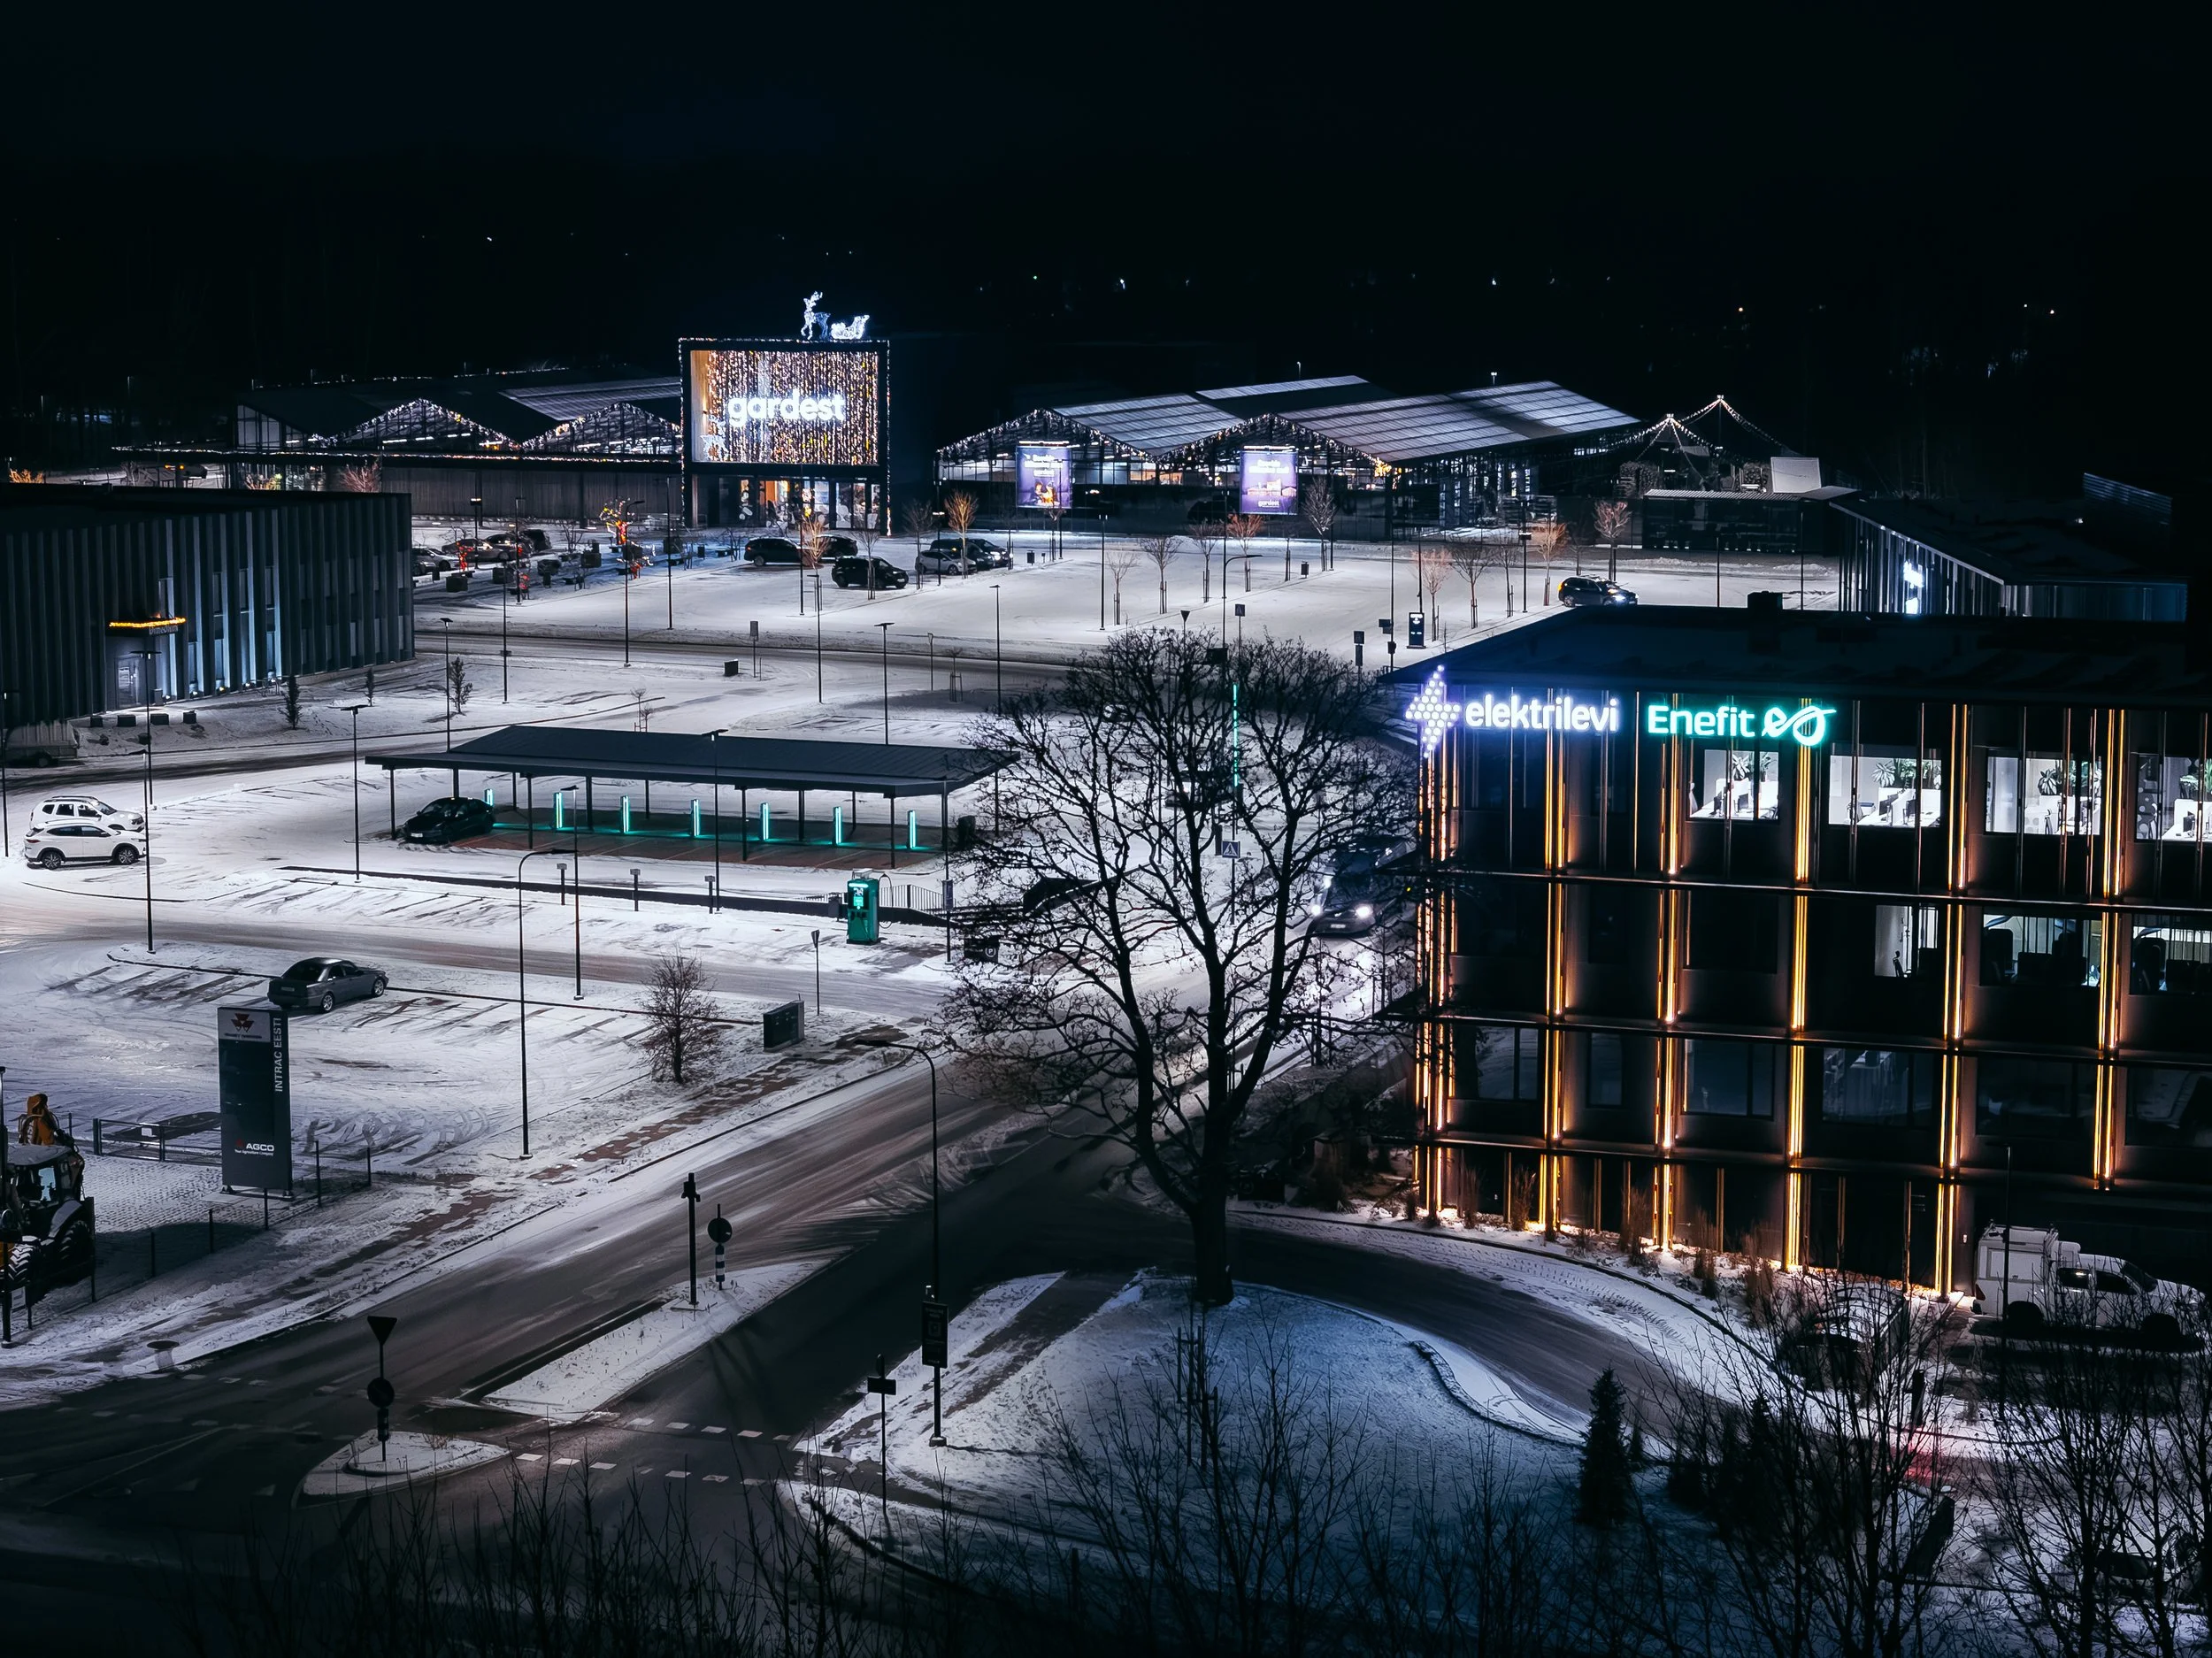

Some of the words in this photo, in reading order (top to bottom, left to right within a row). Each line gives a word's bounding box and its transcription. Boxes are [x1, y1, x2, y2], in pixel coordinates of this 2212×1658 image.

[728, 389, 846, 427] gardest
[1465, 695, 1618, 732] elektrilevi
[1647, 705, 1755, 737] Enefit
[273, 1017, 282, 1048] EESTI
[274, 1052, 283, 1092] INTRAC
